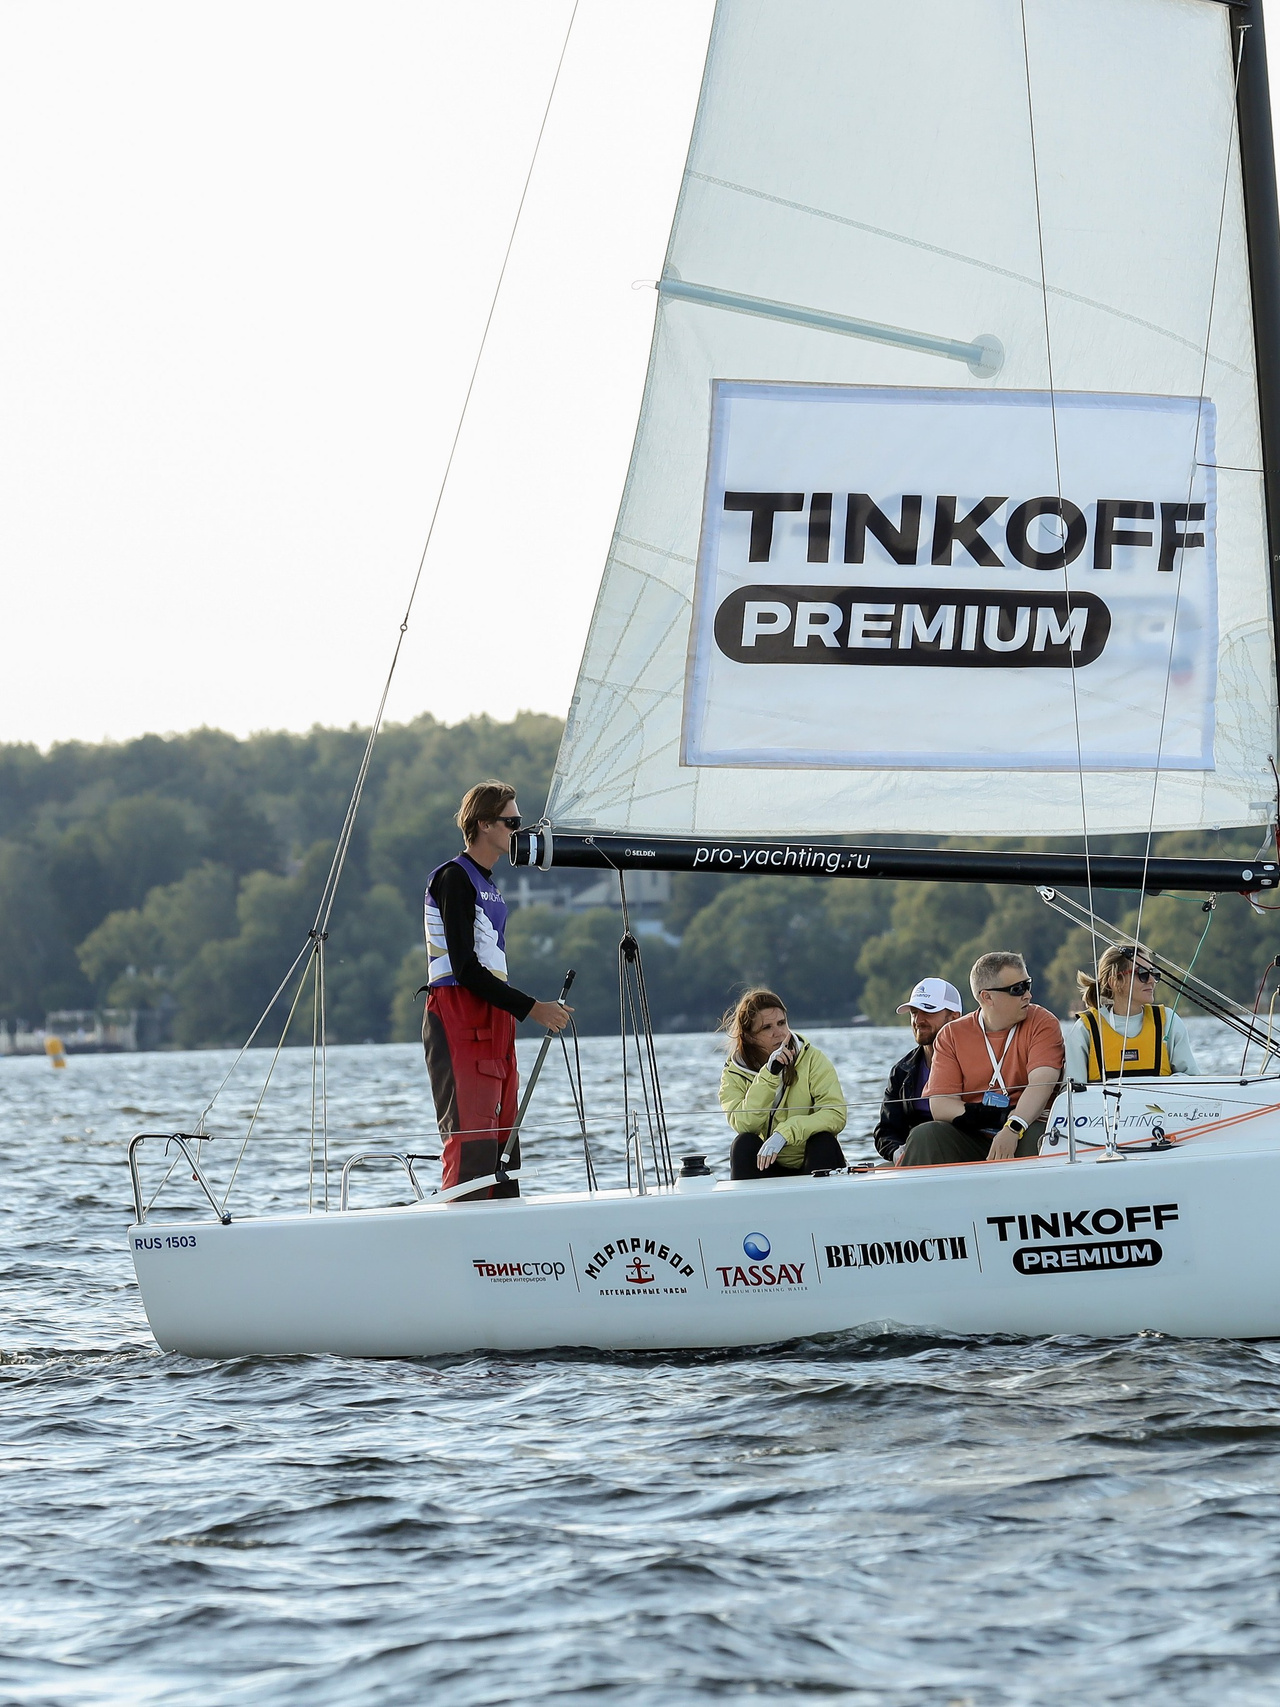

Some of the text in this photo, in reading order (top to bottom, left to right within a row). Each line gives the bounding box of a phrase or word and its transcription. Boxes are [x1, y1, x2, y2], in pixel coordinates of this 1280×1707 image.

[724, 491, 1206, 571] TINKOFF
[740, 600, 1089, 653] PREMIUM
[693, 844, 871, 873] pro-yachting.ru
[986, 1203, 1179, 1242] TINKOFF
[134, 1235, 197, 1250] RUS 1503
[824, 1236, 969, 1270] ВЕДОМОСТИ
[1021, 1244, 1153, 1270] PREMIUM
[584, 1237, 695, 1280] МОРПРИБОР
[715, 1262, 806, 1287] TASSAY
[599, 1288, 661, 1296] ЛЕГЕНДАРНЫЕ
